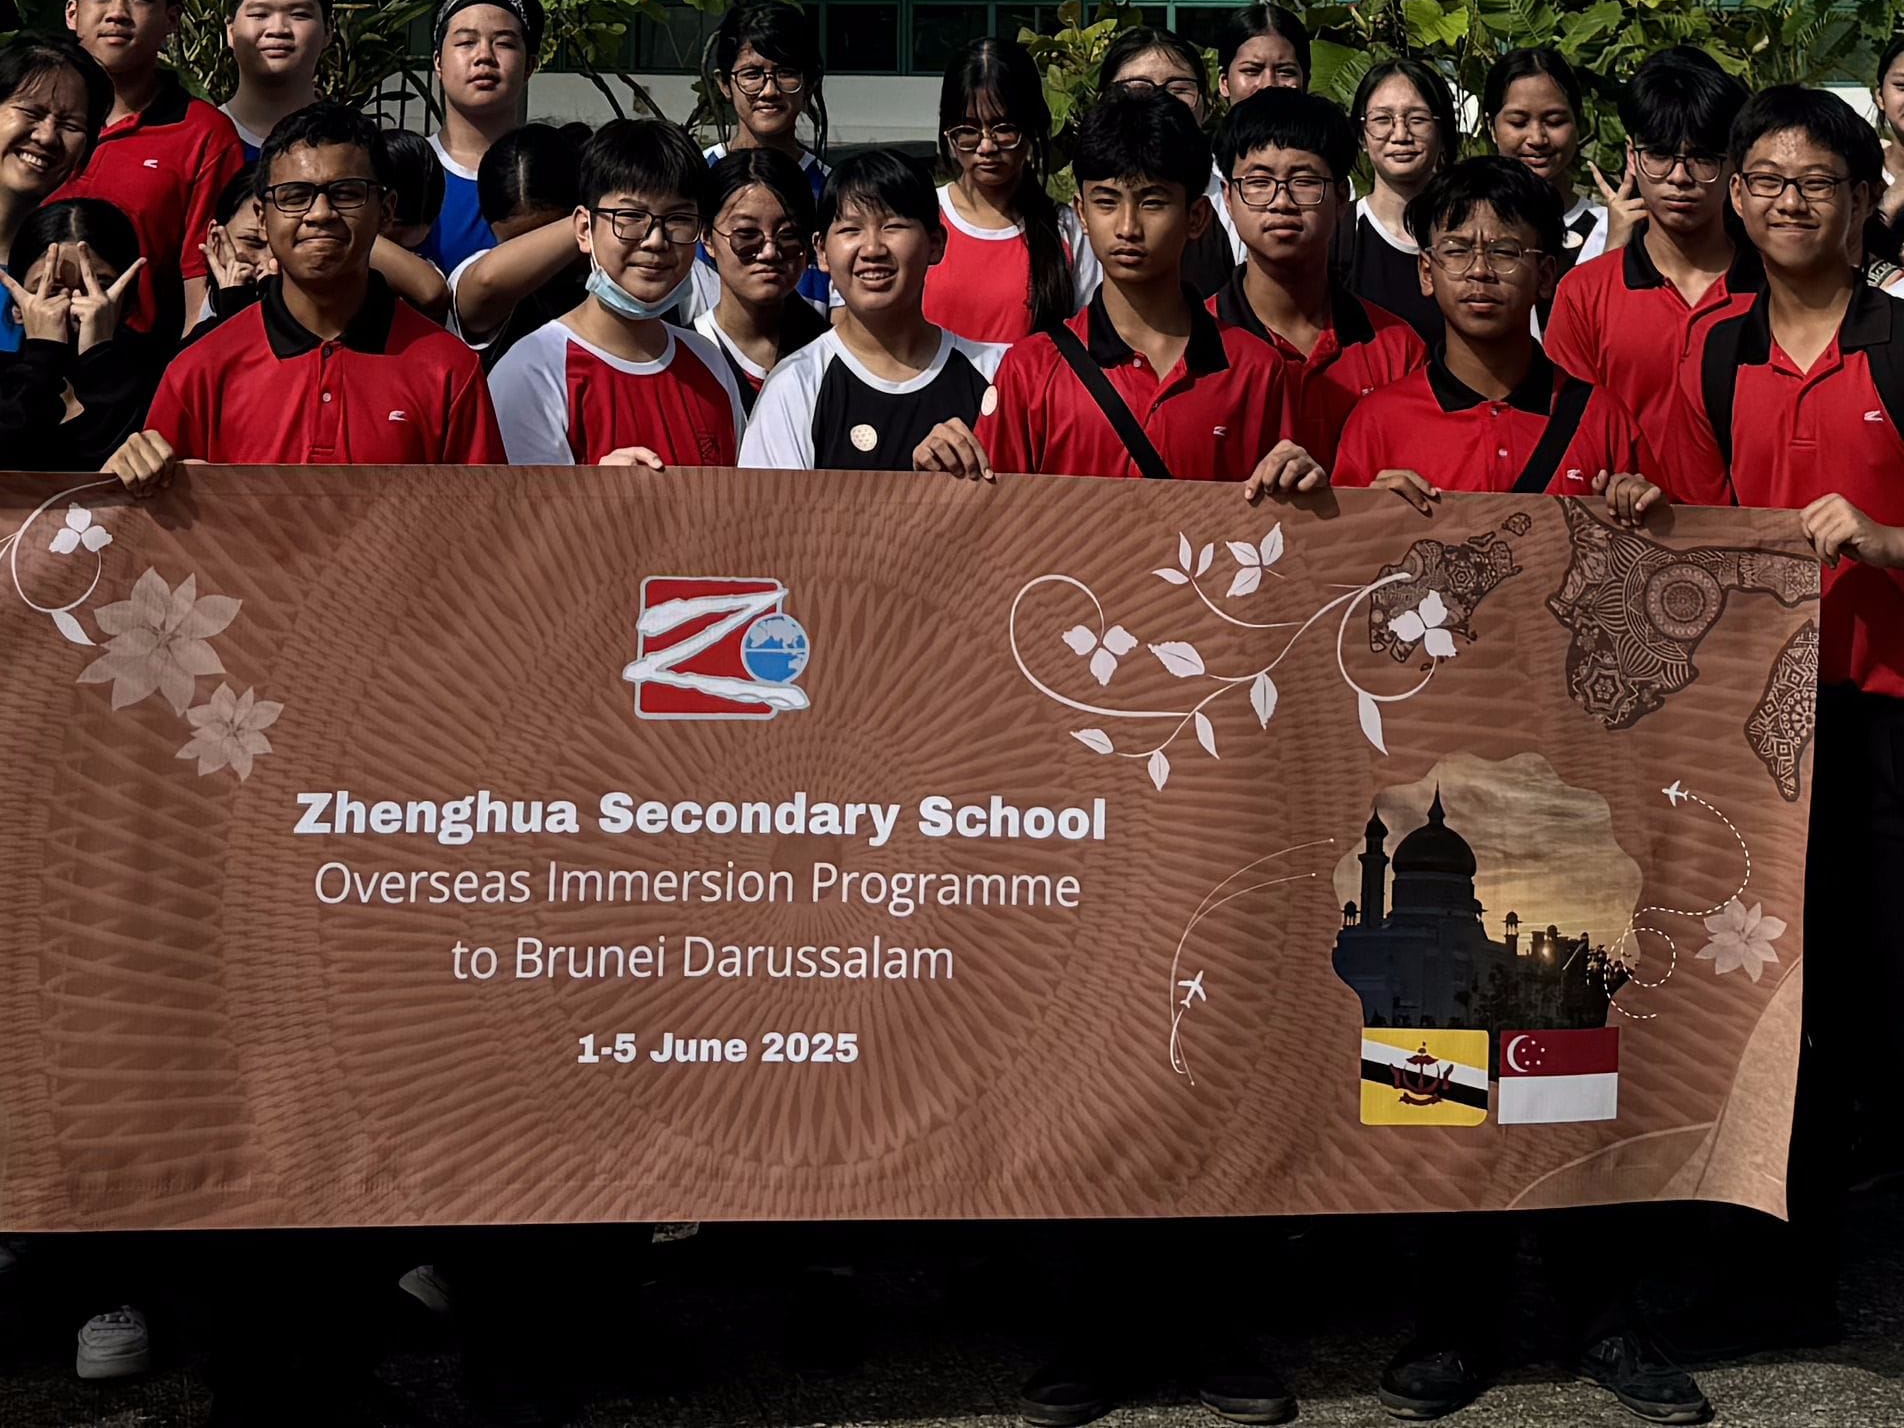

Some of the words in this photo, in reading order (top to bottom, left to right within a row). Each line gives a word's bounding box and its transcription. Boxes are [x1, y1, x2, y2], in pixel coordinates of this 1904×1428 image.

[294, 791, 580, 845] Zhenghua
[599, 792, 902, 846] Secondary
[919, 796, 1107, 841] School
[314, 862, 532, 904] Overseas
[549, 861, 795, 904] Immersion
[813, 862, 1082, 917] Programme
[451, 941, 499, 980] to
[516, 937, 667, 979] Brunei
[684, 936, 954, 980] Darussalam
[577, 1033, 637, 1064] 1-5
[649, 1033, 748, 1064] June
[762, 1033, 860, 1064] 2025
